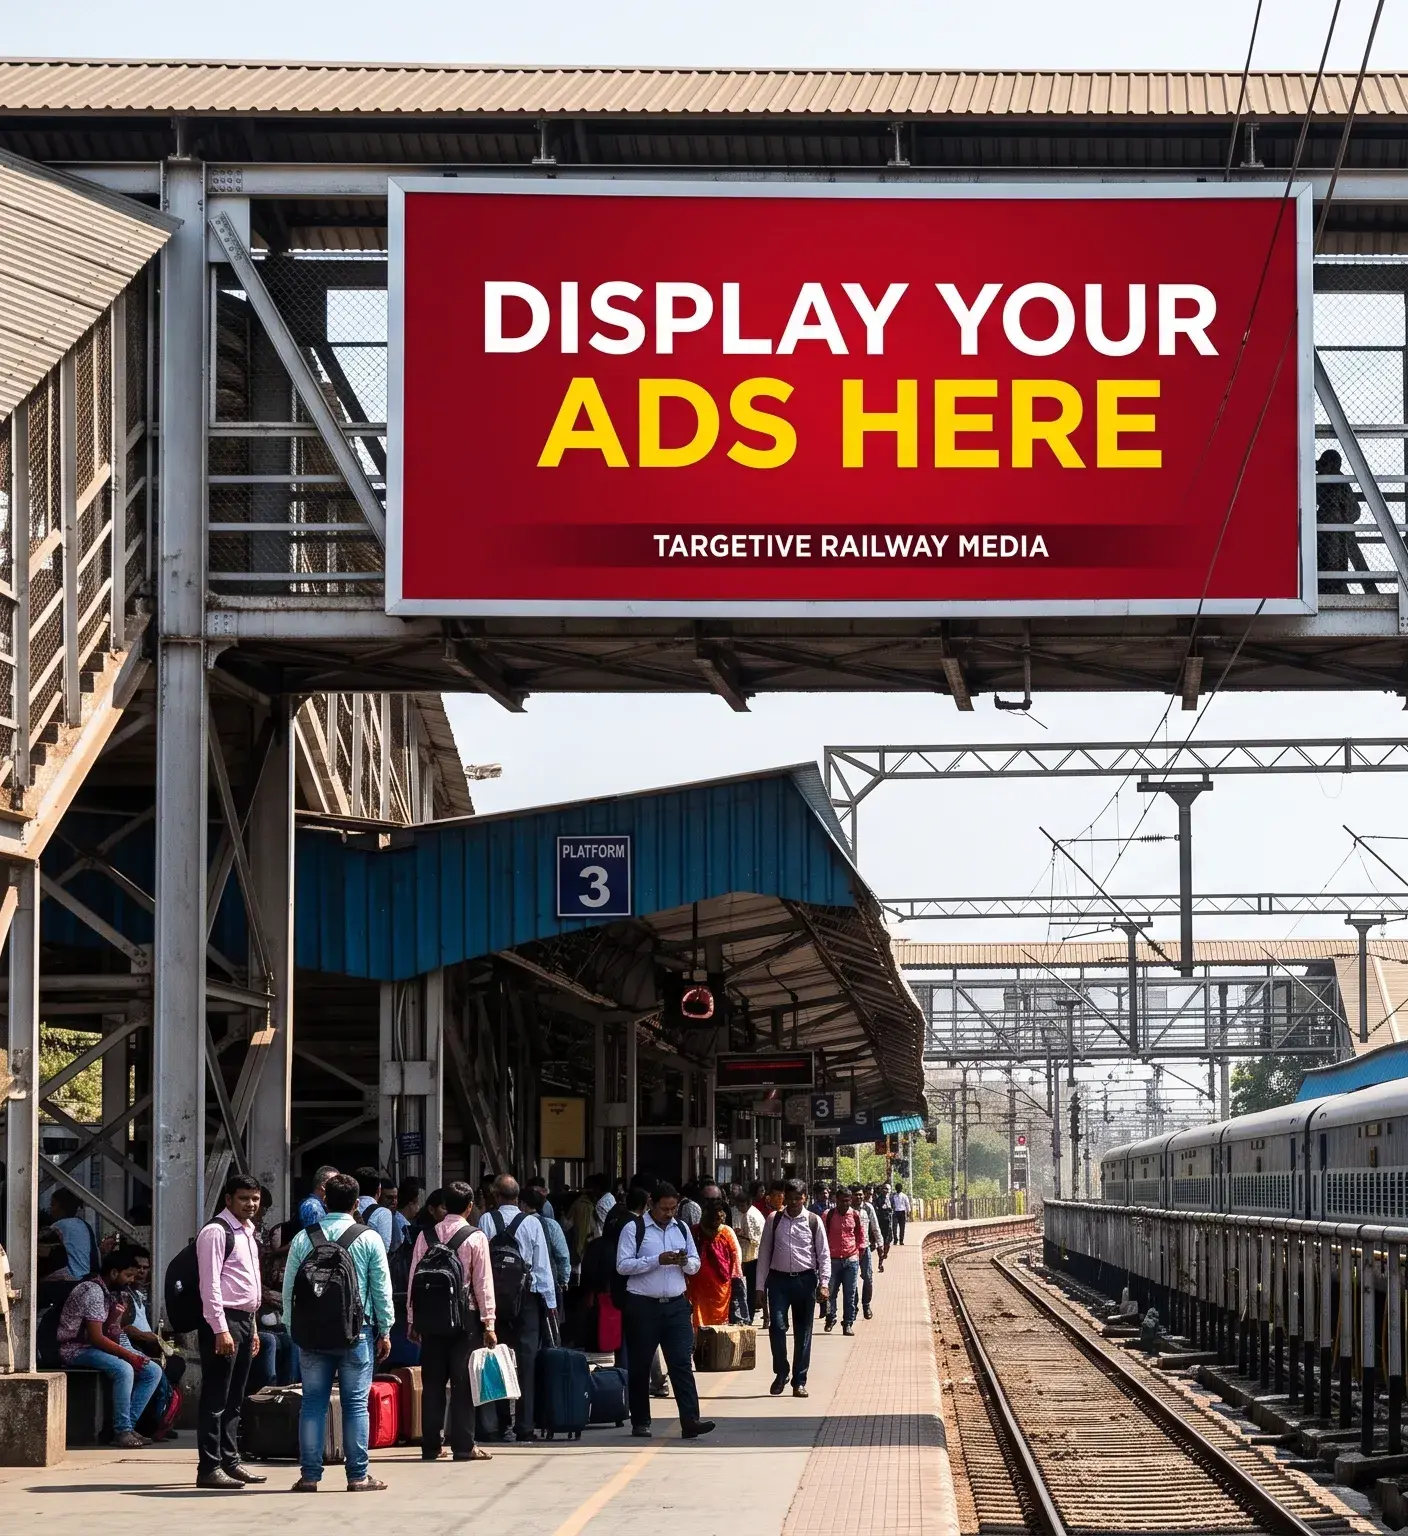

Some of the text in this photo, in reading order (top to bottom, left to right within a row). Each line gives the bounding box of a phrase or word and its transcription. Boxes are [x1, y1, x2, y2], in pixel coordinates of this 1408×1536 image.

[484, 280, 1220, 357] DISPLAY YOUR
[536, 376, 1163, 469] ADS HERE
[653, 534, 1050, 558] TARGETIVE RAILWAY MEDIA
[562, 844, 625, 859] PLATFORM
[578, 865, 611, 908] 3
[815, 1099, 830, 1118] 3
